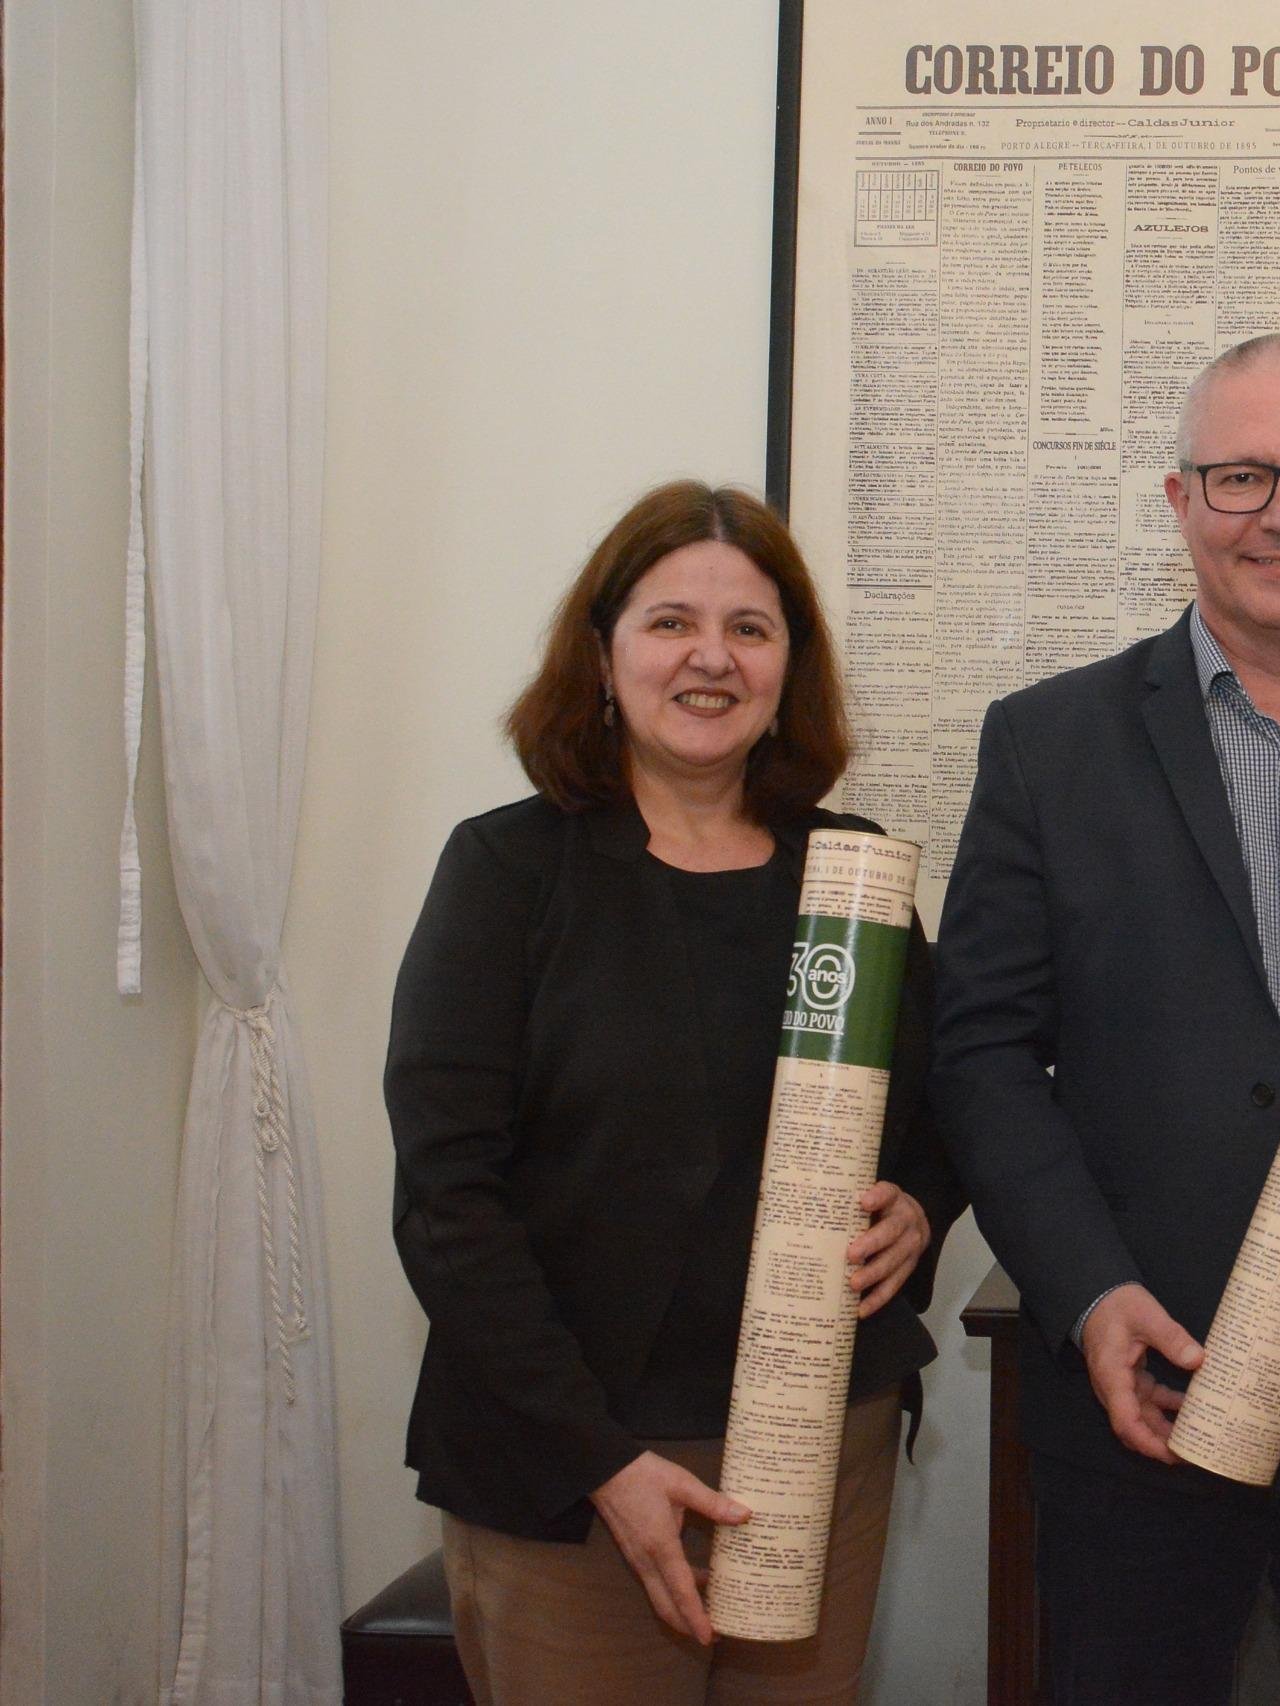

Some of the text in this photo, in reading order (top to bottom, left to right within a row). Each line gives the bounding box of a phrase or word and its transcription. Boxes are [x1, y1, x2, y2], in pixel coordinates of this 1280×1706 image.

[905, 44, 1114, 95] CORREIO
[1140, 44, 1205, 96] DO
[865, 116, 887, 125] ANNO
[906, 120, 919, 128] Rua
[1015, 118, 1070, 129] Proprietario
[1079, 118, 1114, 128] director
[1001, 141, 1031, 150] PORTO
[1033, 141, 1070, 150] ALEGRE
[1155, 142, 1169, 150] DE
[1171, 142, 1215, 150] OUTUBRO
[1219, 142, 1232, 150] DE
[1235, 142, 1257, 150] 1895
[953, 162, 1023, 172] CORREIO DO POVO
[1058, 162, 1103, 171] PETELECOS
[1233, 165, 1263, 174] Pontos
[1264, 164, 1276, 173] de
[1133, 224, 1209, 233] AZULEJOS
[1032, 440, 1072, 450] CONCURSOS
[1072, 441, 1083, 450] FIN
[1084, 441, 1094, 451] DE
[864, 590, 915, 601] Declarações
[814, 840, 861, 854] Caldas
[832, 864, 844, 875] DE
[807, 967, 848, 985] anos
[792, 1011, 807, 1027] DO
[808, 1012, 845, 1031] POVO
